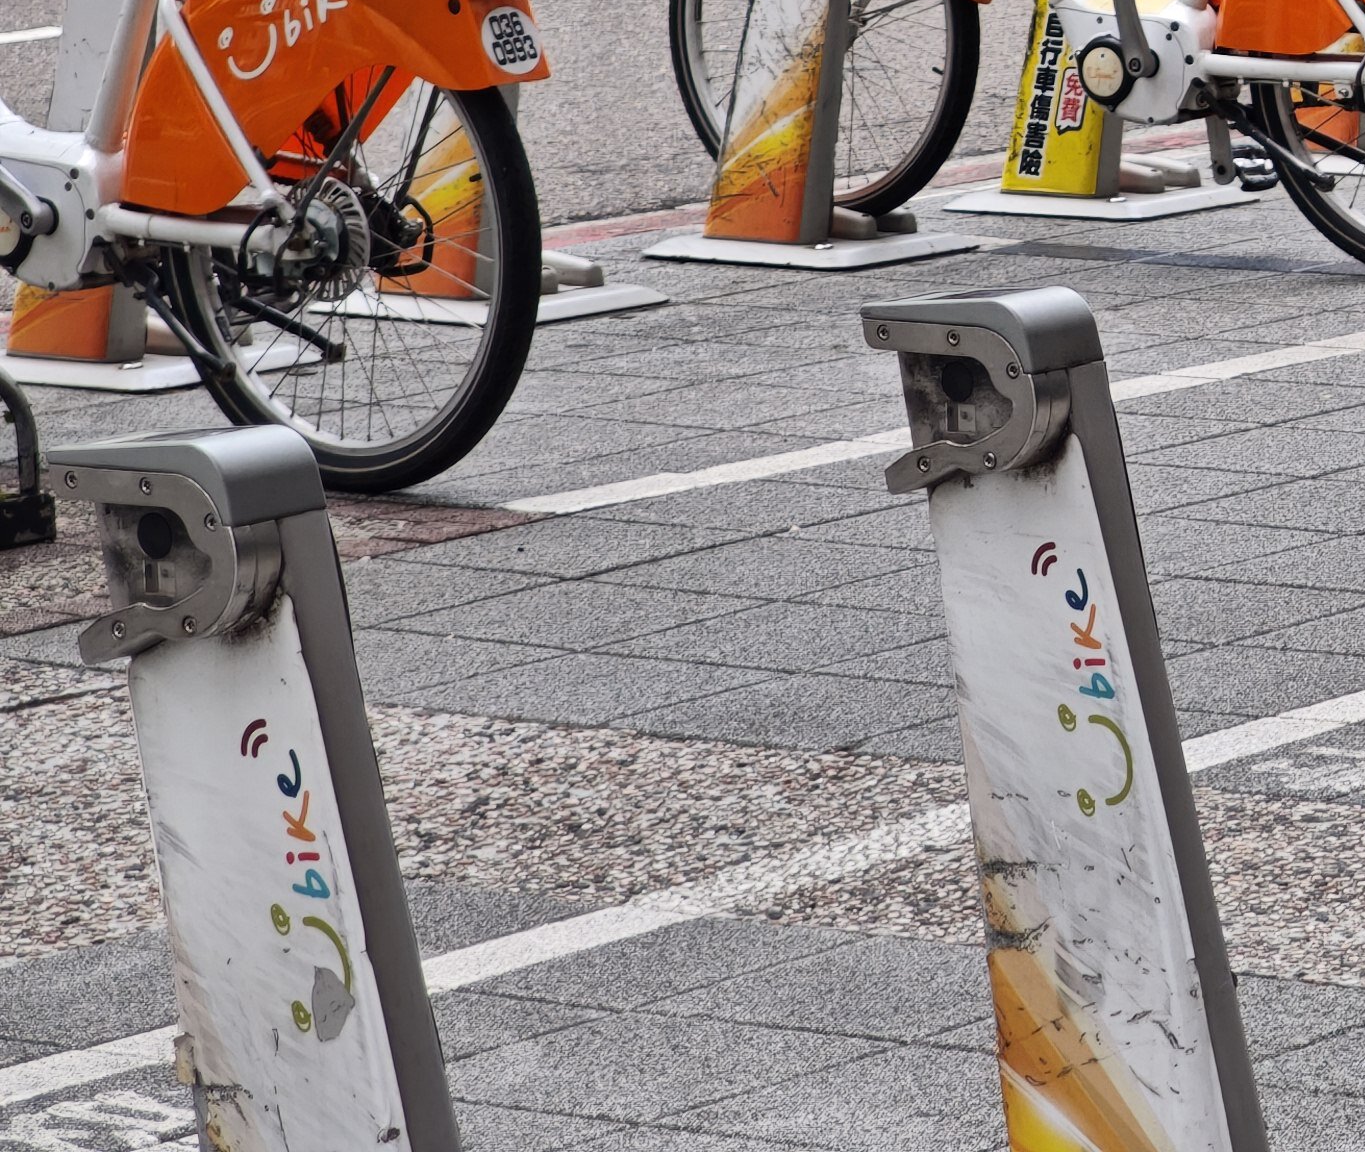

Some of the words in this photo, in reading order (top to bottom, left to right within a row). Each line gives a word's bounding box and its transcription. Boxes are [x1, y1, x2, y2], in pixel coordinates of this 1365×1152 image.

[1019, 12, 1064, 177] 自行車傷害險
[1061, 72, 1084, 123] 免費
